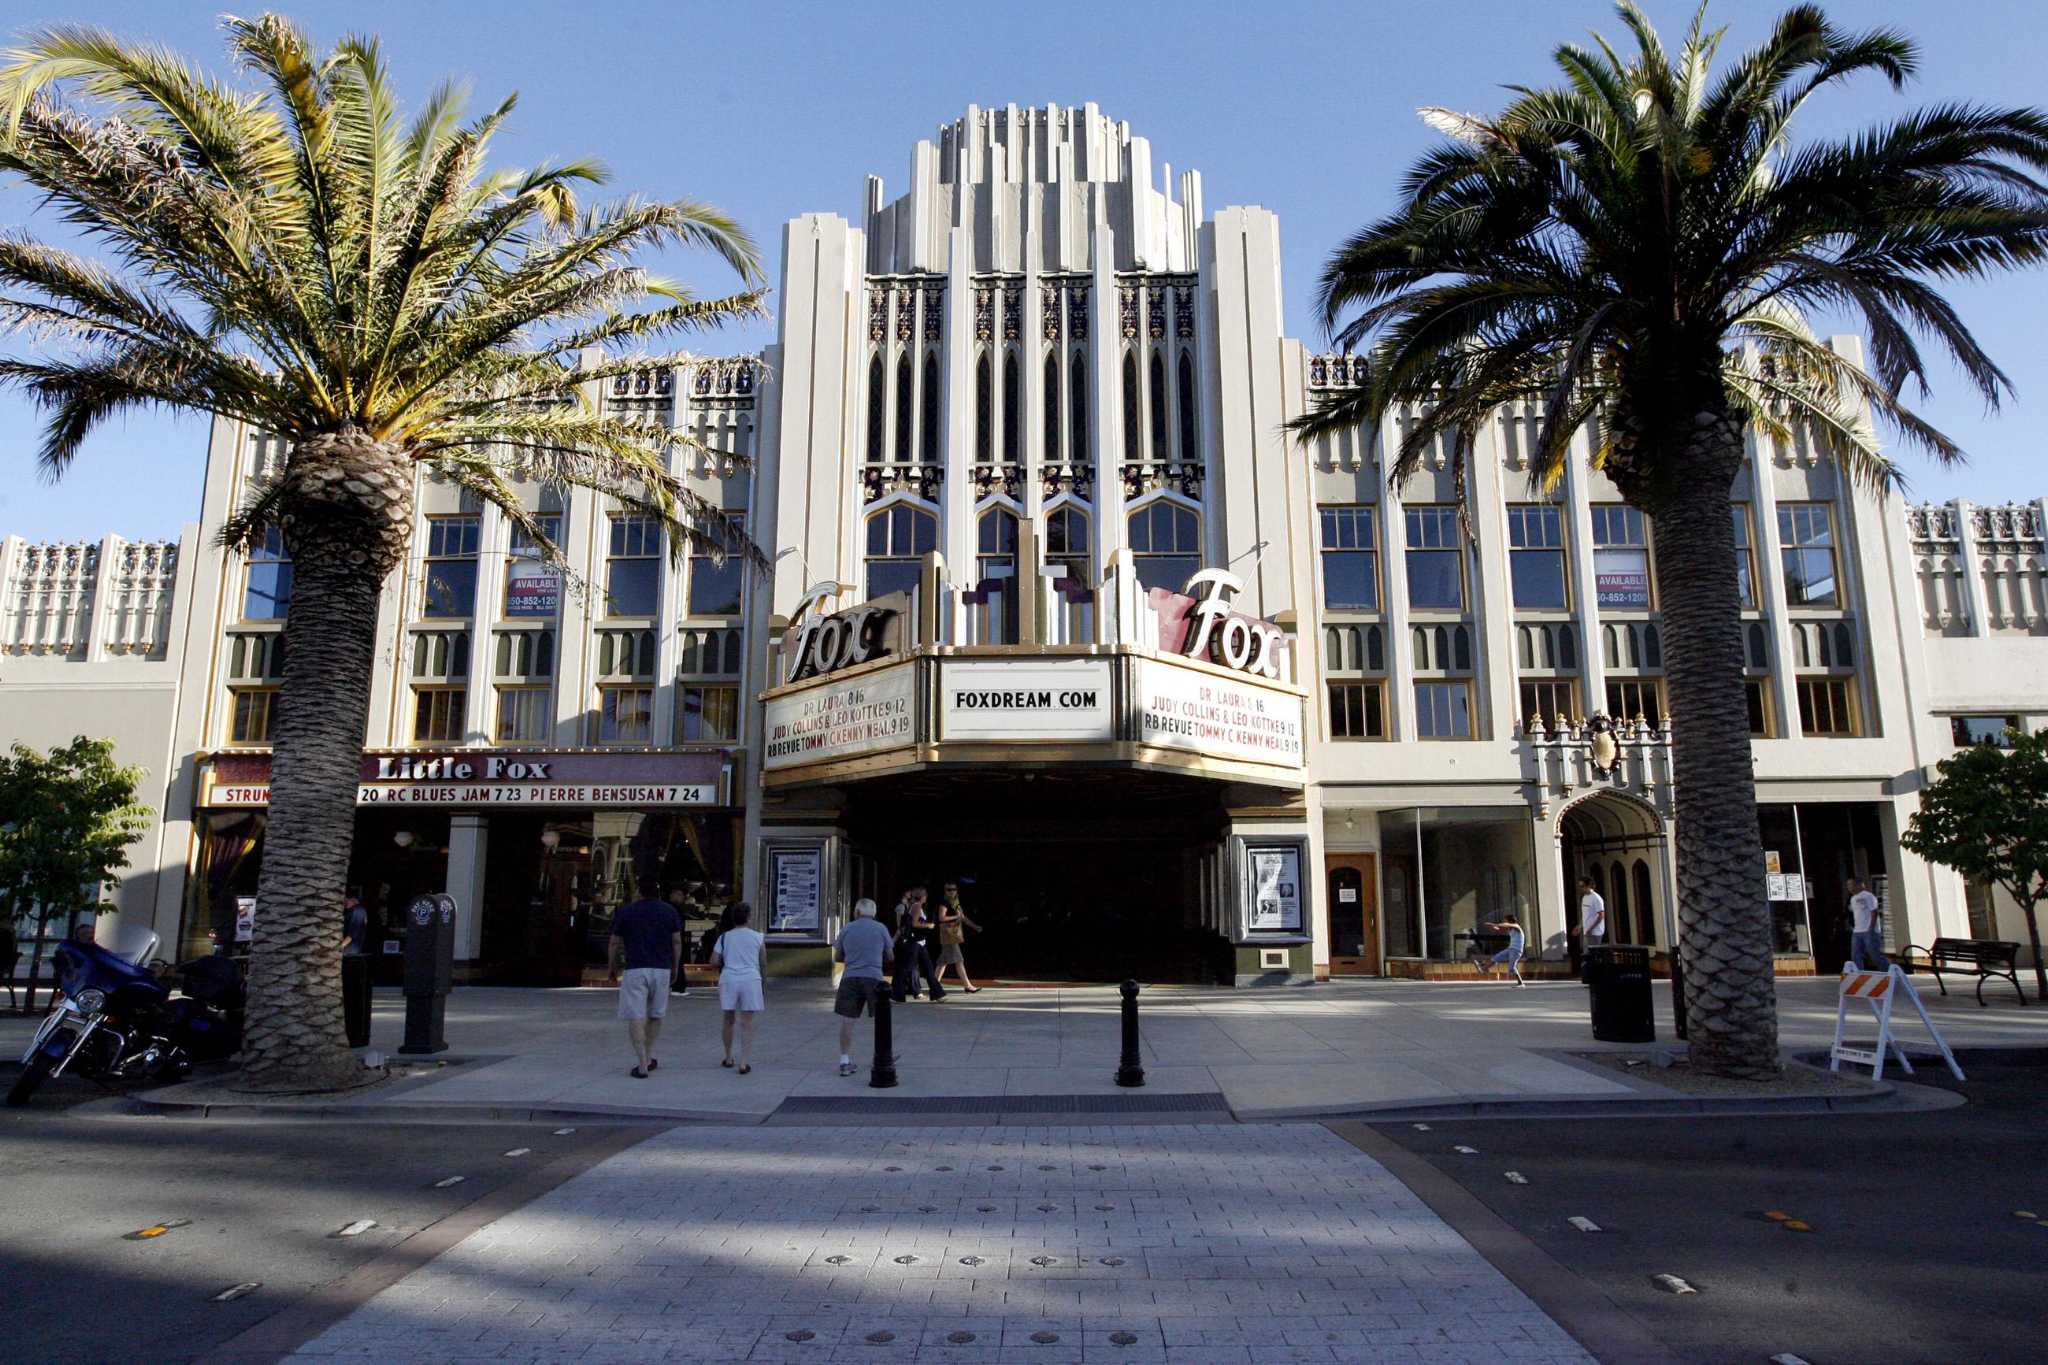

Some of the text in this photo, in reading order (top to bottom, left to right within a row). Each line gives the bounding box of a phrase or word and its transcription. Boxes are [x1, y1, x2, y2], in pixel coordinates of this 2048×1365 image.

[785, 580, 884, 684] Fox
[1185, 568, 1283, 678] Fox
[804, 701, 814, 716] DR
[817, 693, 844, 712] LAURA
[848, 691, 854, 705] 8
[956, 692, 1096, 708] FOXDREAM COM
[1151, 696, 1177, 714] JUDY
[1182, 701, 1220, 722] COLLINS
[1223, 709, 1229, 724] &
[1232, 712, 1248, 727] LEO
[1251, 716, 1280, 734] KOTTKE
[1200, 687, 1211, 702] DR
[1217, 689, 1245, 708] LAURA
[1256, 698, 1265, 713] 16
[768, 741, 778, 758] RB
[778, 739, 800, 756] REVUE
[800, 733, 827, 750] TOMMY
[836, 726, 865, 744] KENNY
[867, 720, 890, 738] NEAL
[773, 724, 791, 741] JUDY
[792, 715, 823, 734] COLLINS
[825, 715, 831, 729] &
[833, 710, 848, 726] LEO
[850, 703, 884, 722] KOTTKE
[1145, 713, 1159, 729] RB
[1162, 716, 1192, 736] REVUE
[1194, 722, 1225, 741] TOMMY
[1228, 728, 1233, 743] C
[1236, 730, 1263, 748] KENNY
[1265, 735, 1284, 752] NEAL
[376, 757, 551, 780] Little Fox
[362, 788, 379, 802] 20
[388, 788, 406, 801] RC
[412, 788, 456, 801] BLUES
[462, 788, 490, 801] JAM
[495, 788, 502, 801] 7
[507, 788, 521, 801] 23
[592, 788, 665, 801] BENSUSAN
[669, 788, 677, 801] 7
[683, 788, 699, 801] 24
